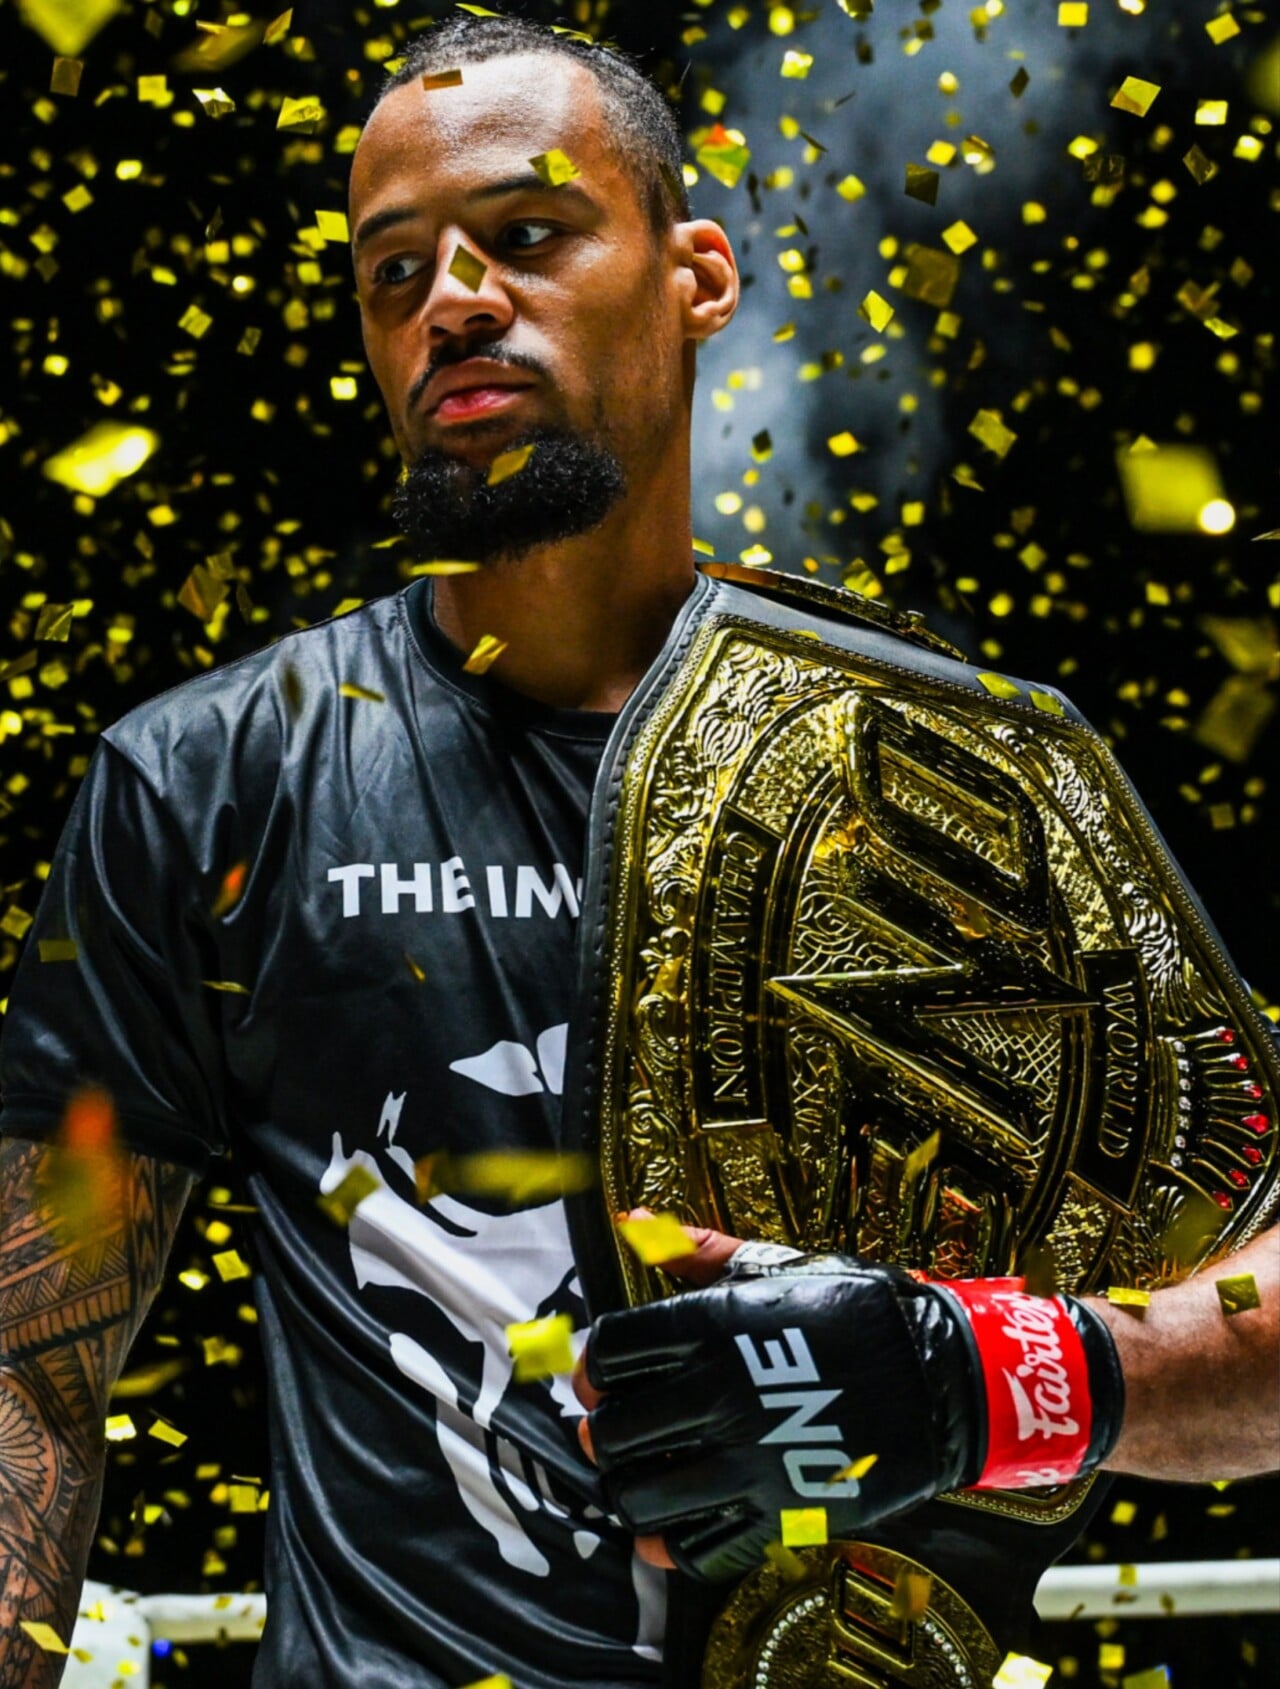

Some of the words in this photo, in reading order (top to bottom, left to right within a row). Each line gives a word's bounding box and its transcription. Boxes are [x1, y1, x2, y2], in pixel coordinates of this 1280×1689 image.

[327, 855, 477, 919] THE
[485, 862, 584, 920] IM
[709, 831, 762, 1106] CHAMPION
[1098, 977, 1139, 1160] WORLD
[733, 1327, 861, 1499] ONE
